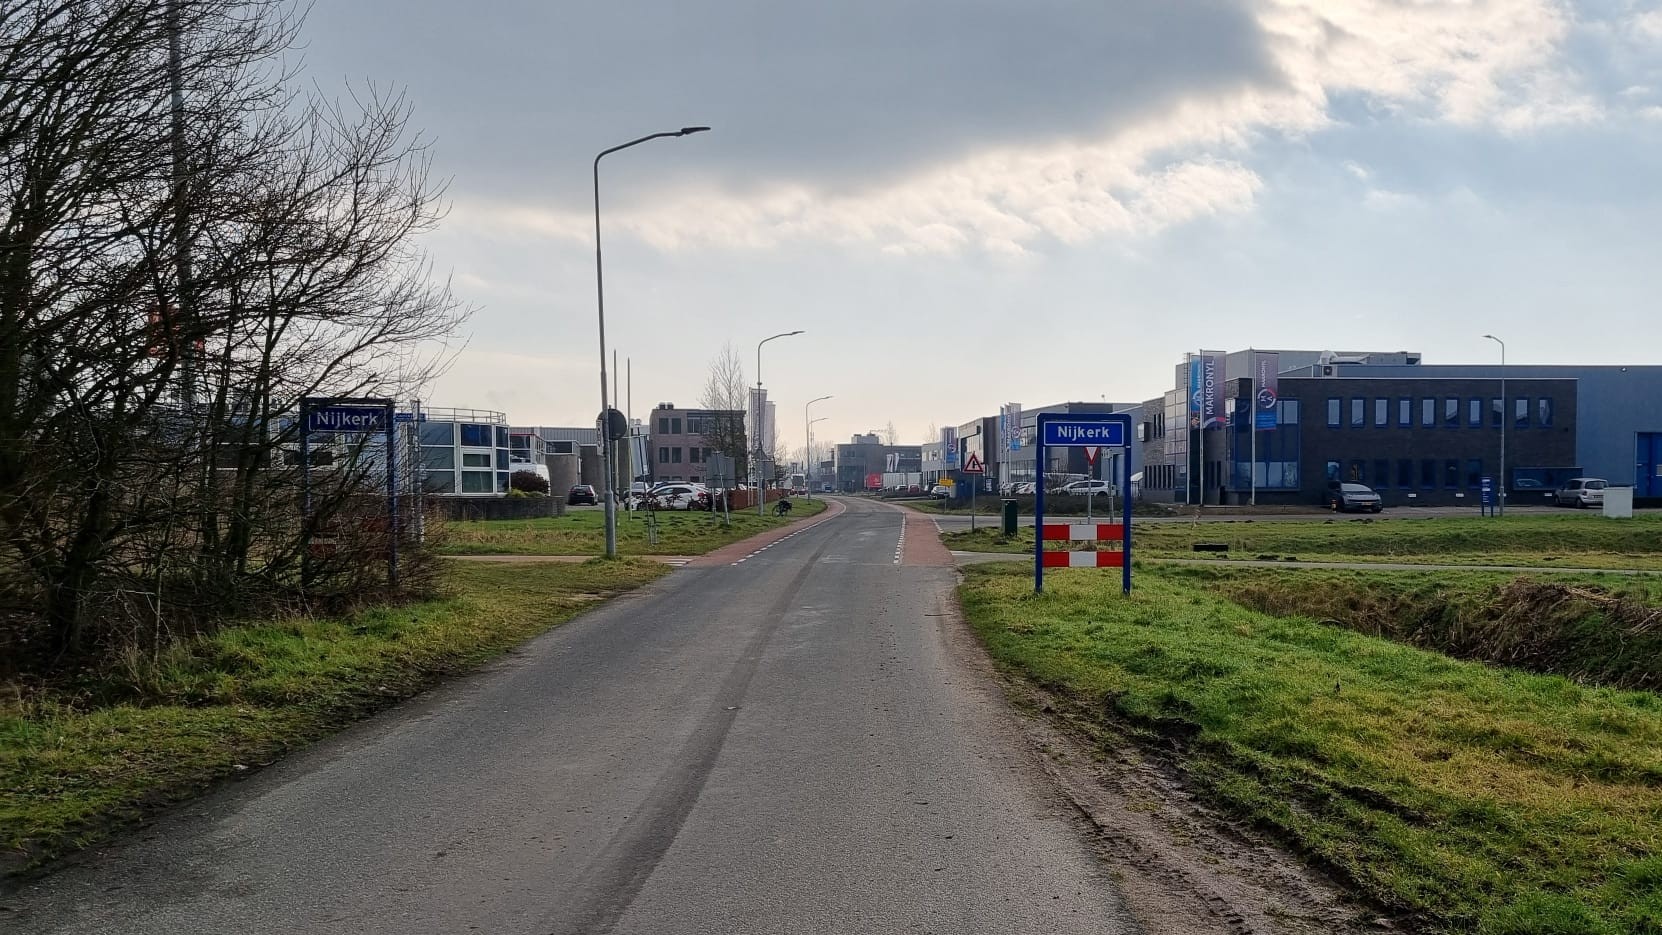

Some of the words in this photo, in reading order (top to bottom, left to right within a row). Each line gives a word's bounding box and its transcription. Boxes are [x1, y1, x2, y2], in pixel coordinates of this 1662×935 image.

[1206, 360, 1215, 415] MAKRONYL
[317, 412, 378, 428] Nijkerk
[1057, 426, 1110, 441] Nijkerk
